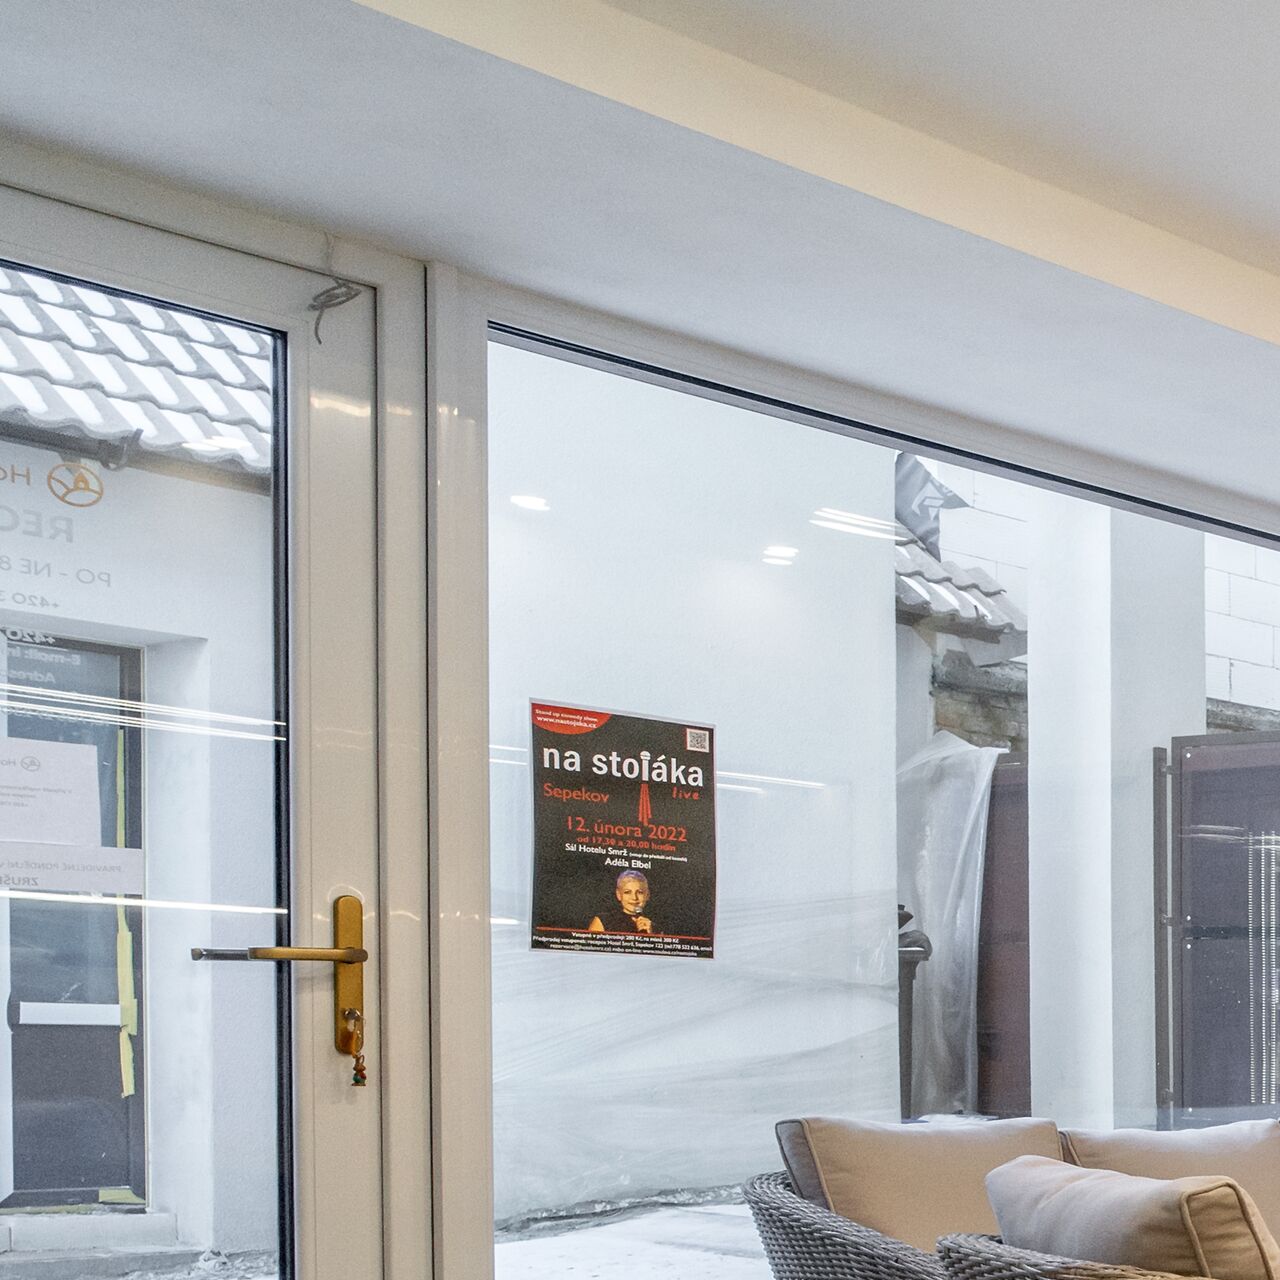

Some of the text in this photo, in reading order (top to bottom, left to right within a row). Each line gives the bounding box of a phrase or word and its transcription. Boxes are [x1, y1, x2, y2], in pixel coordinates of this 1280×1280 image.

[543, 747, 581, 772] na
[543, 783, 610, 804] Sepekov
[672, 786, 700, 801] live
[567, 815, 688, 842] 12. února 2022
[565, 842, 577, 851] Sál
[578, 844, 607, 855] Hotelu
[608, 847, 628, 857] Smrž
[604, 857, 629, 868] Adéla
[631, 859, 652, 870] Elbel
